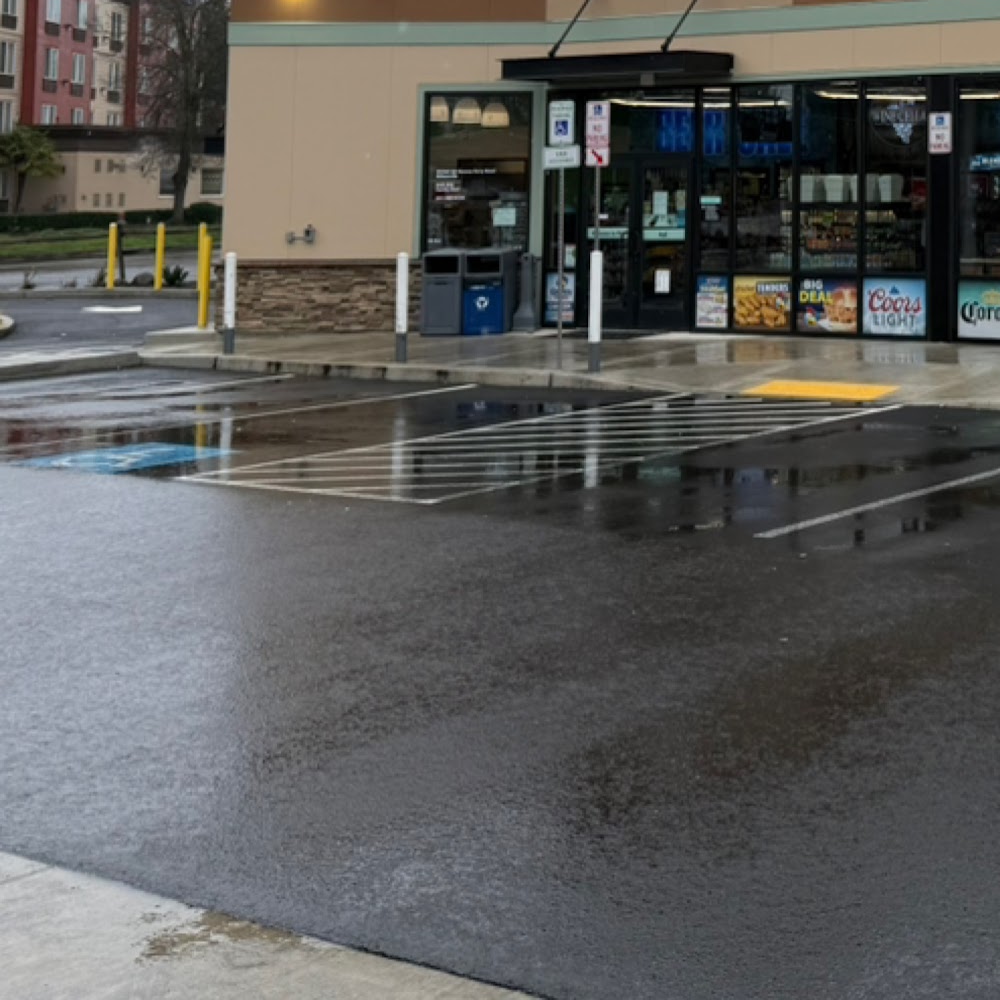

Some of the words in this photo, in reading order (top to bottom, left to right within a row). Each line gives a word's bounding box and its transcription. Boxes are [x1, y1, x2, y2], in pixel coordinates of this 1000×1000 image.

[803, 279, 824, 290] BIG
[799, 290, 835, 306] DEAL
[868, 288, 922, 314] Coors
[872, 313, 916, 327] LIGHT
